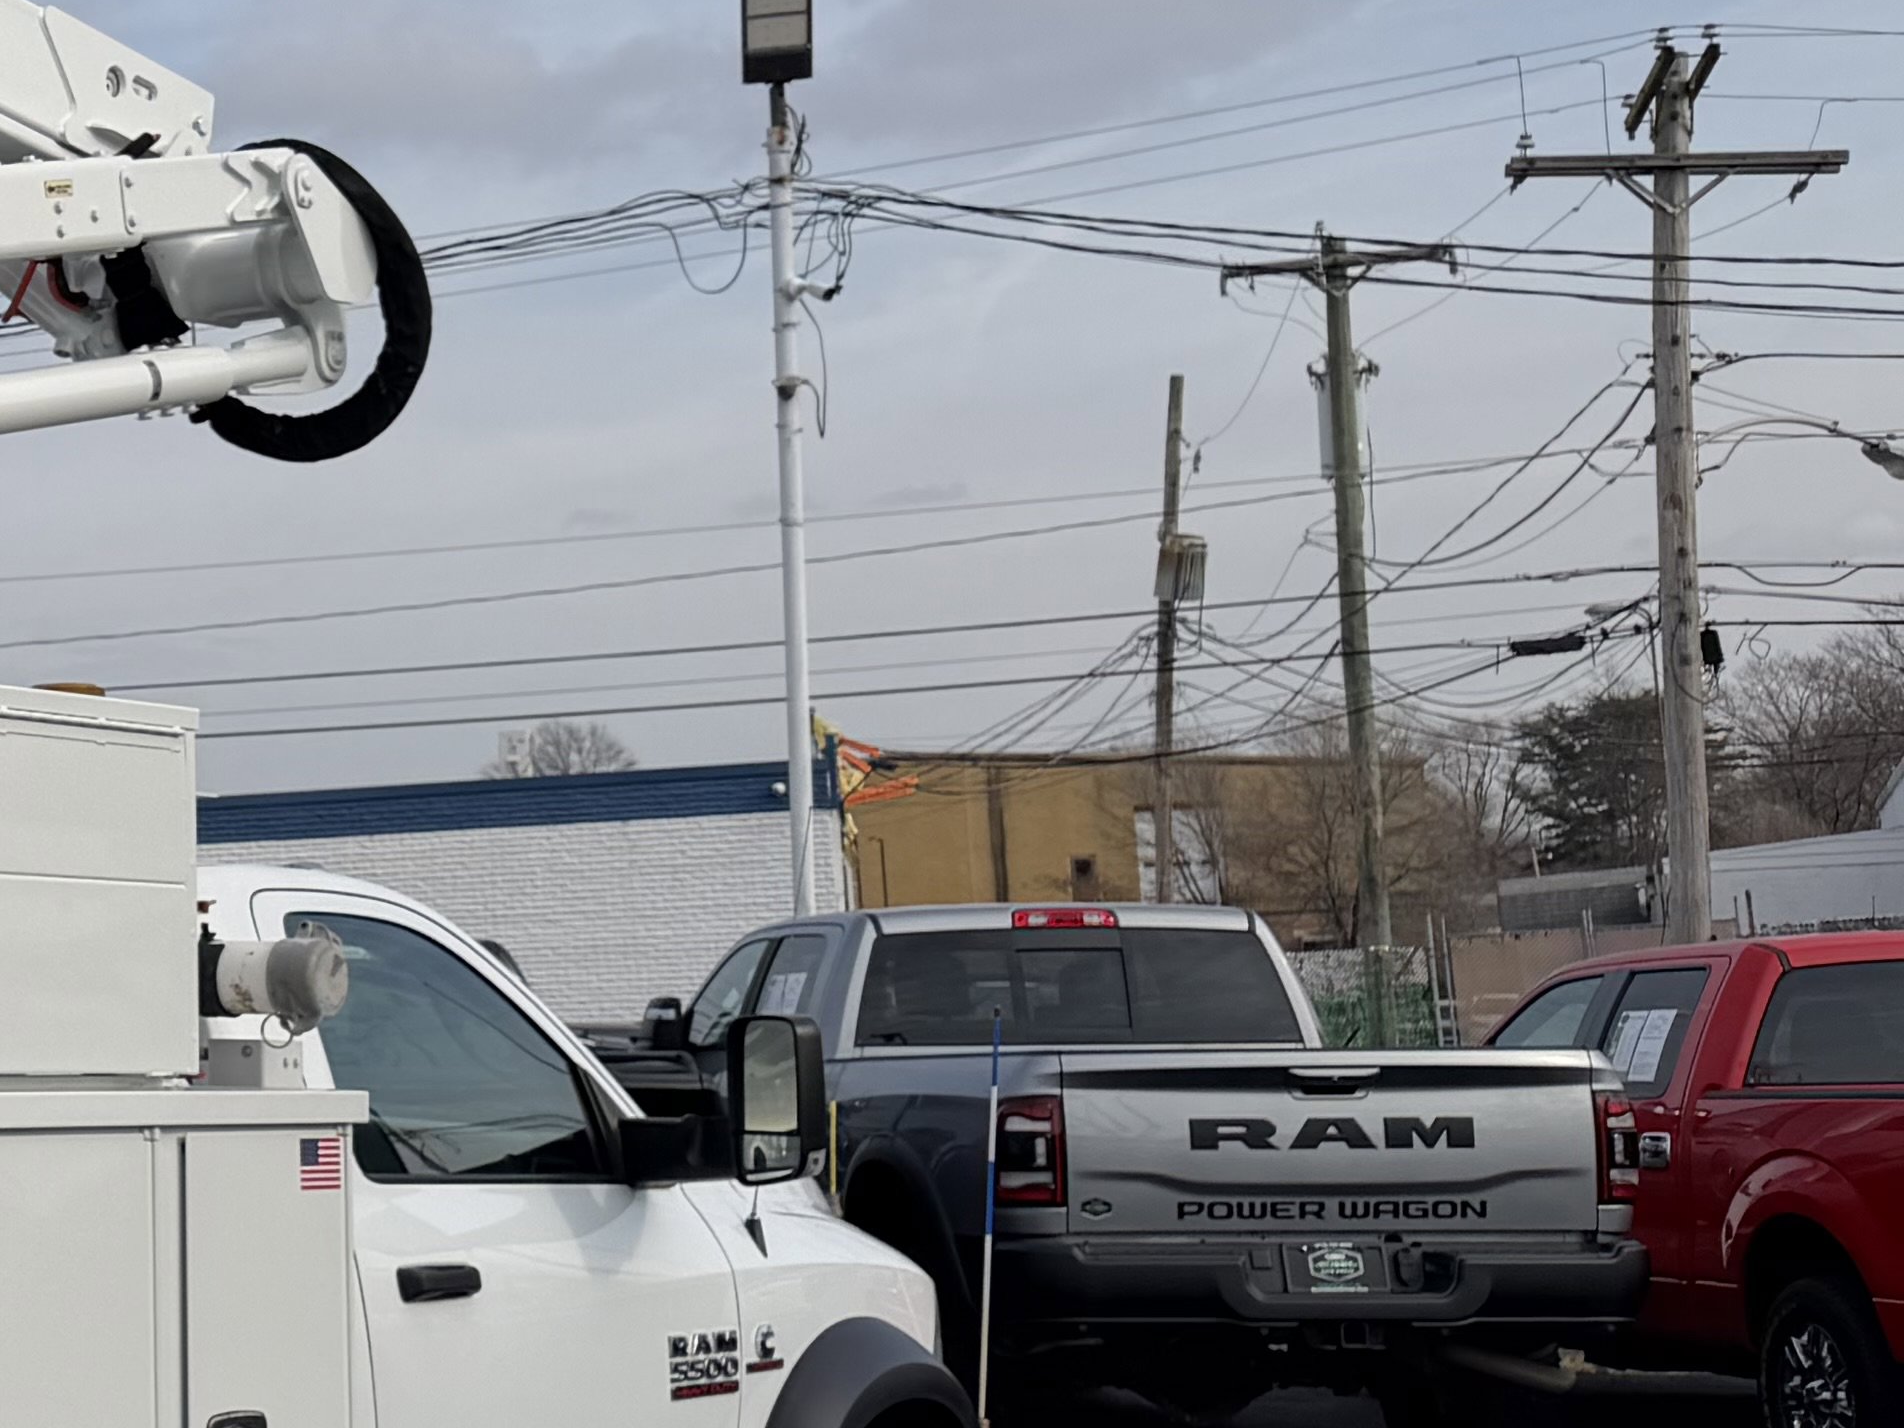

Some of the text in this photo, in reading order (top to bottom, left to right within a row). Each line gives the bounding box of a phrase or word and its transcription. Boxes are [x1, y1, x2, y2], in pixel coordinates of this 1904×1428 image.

[1188, 1116, 1475, 1150] RAM
[1177, 1200, 1488, 1220] POWER WAGON
[668, 1330, 738, 1358] RAM
[669, 1356, 739, 1383] 5500
